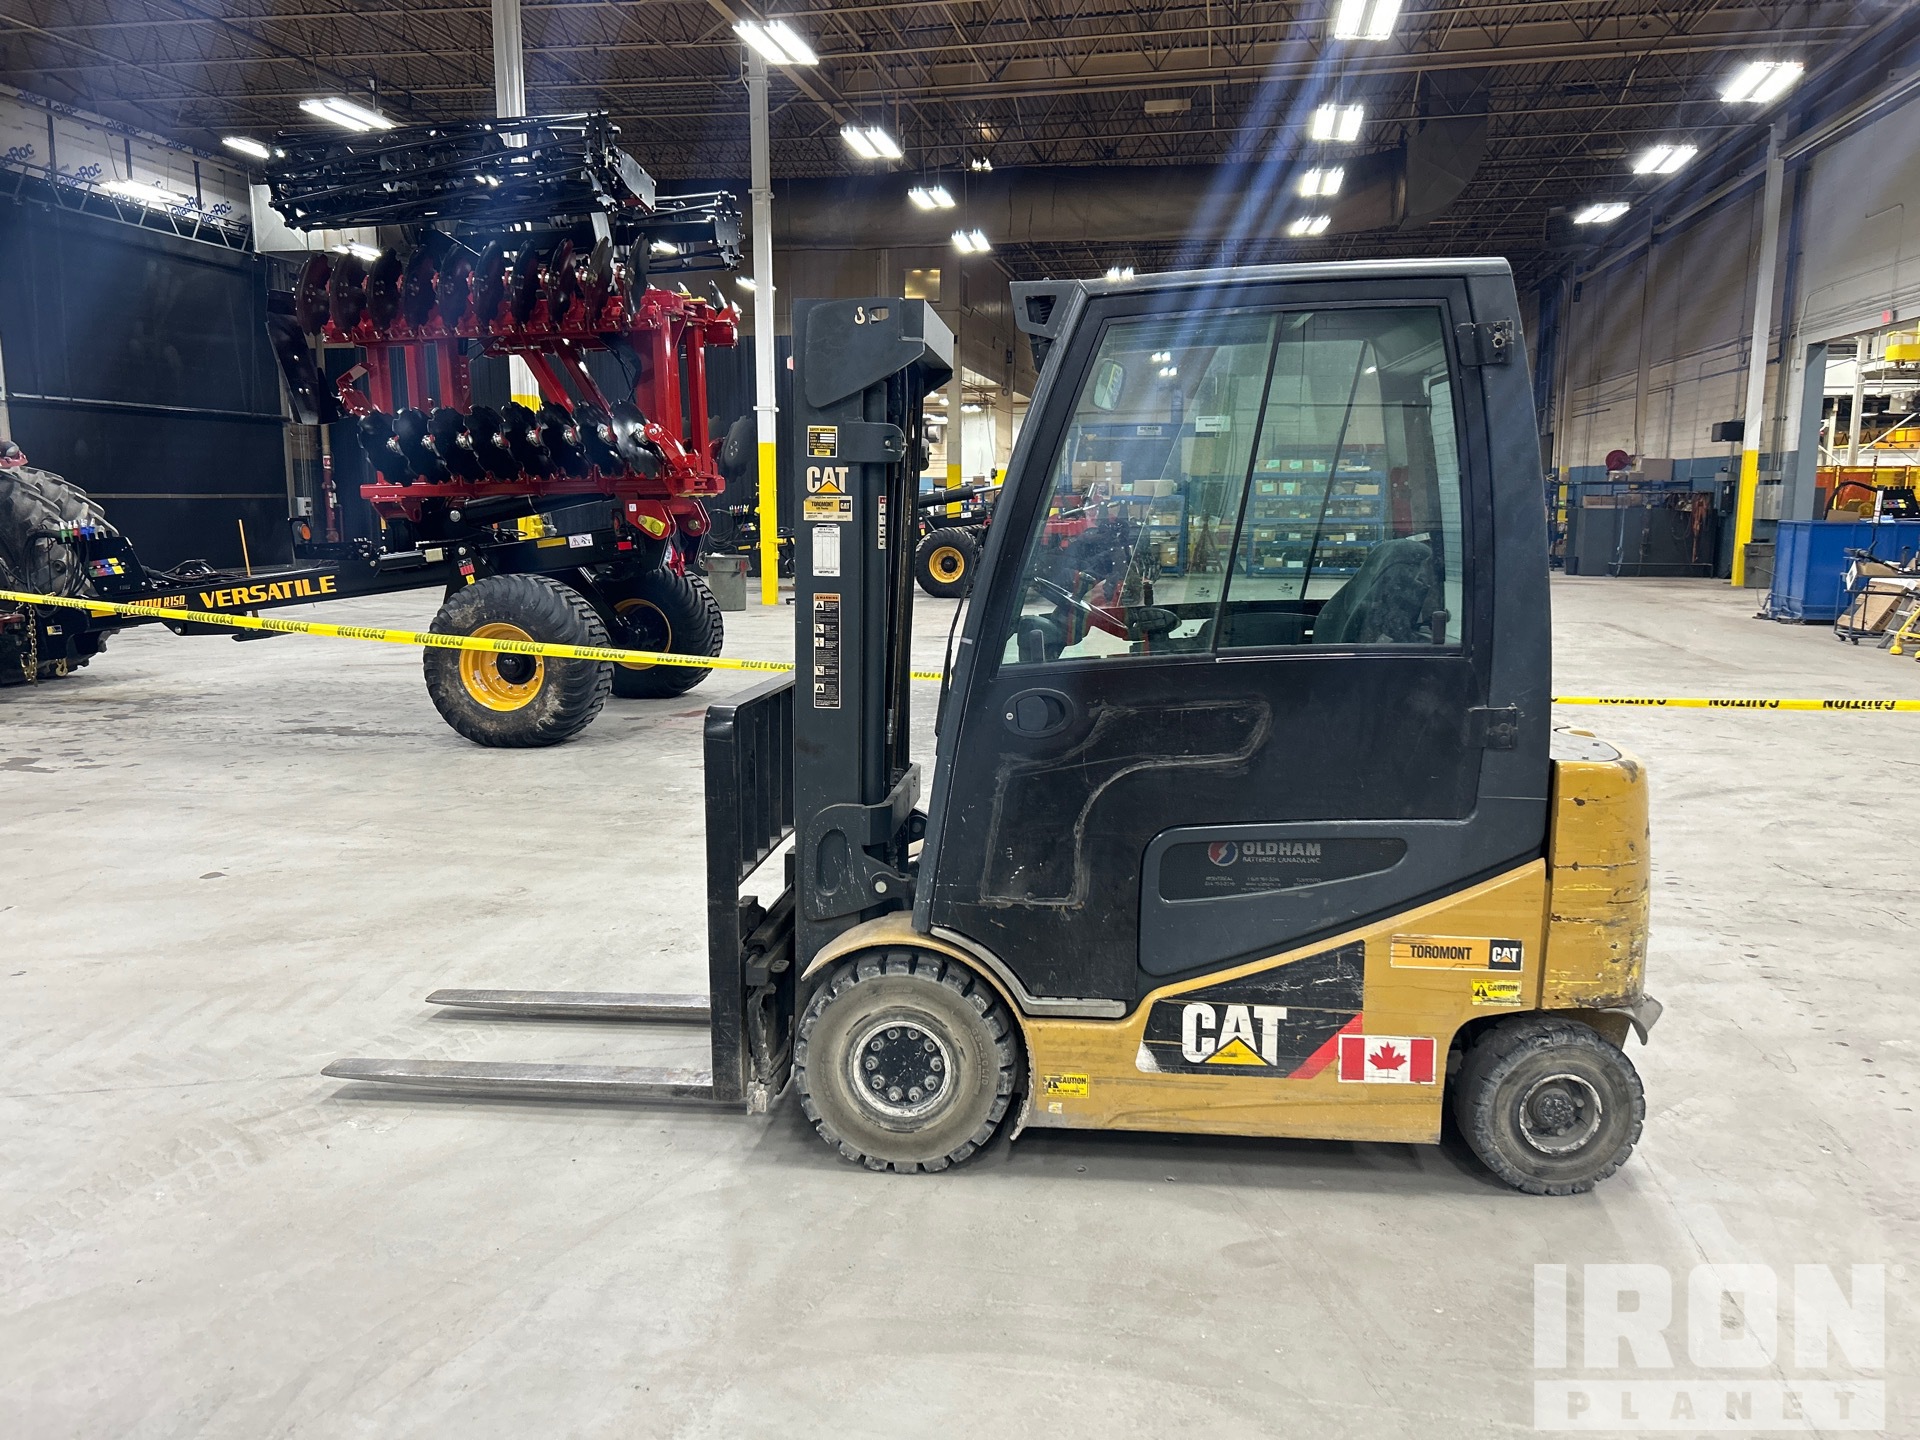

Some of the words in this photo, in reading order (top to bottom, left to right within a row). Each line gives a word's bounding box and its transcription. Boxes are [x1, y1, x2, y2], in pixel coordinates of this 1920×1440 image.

[806, 466, 849, 494] CAT
[200, 575, 337, 609] VERSATILE
[163, 594, 186, 607] R150
[1242, 842, 1321, 856] OLDHAM
[1410, 945, 1472, 960] TOROMONT
[1492, 946, 1519, 963] CAT
[1487, 984, 1519, 992] CAUTION
[1182, 1002, 1288, 1066] CAT
